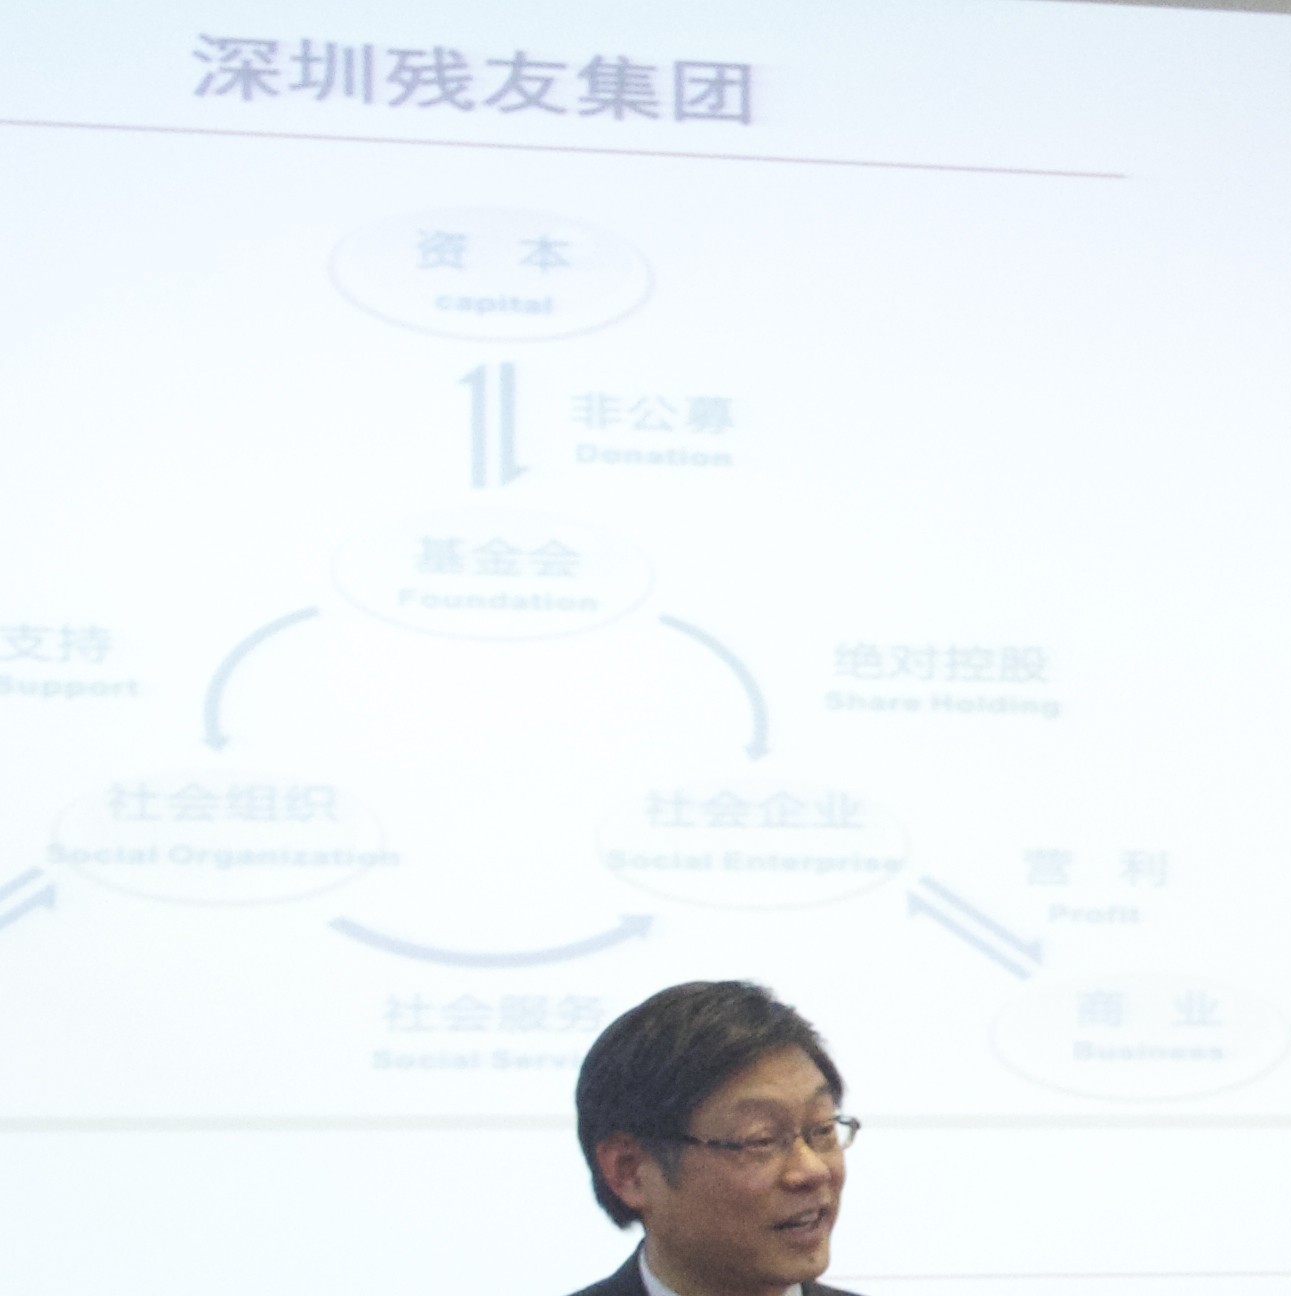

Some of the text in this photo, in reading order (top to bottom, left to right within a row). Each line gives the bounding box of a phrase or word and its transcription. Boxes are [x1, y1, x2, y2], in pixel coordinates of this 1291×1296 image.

[193, 33, 756, 126] 深圳残友集团
[434, 291, 555, 317] capital
[576, 443, 734, 469] Donation
[414, 536, 582, 578] 基金会
[397, 587, 599, 613] Foundation
[824, 689, 1062, 720] Share Holding
[644, 788, 866, 830] 社会企业
[46, 842, 403, 870] Social Organization
[605, 847, 904, 876] Social Enterprise
[1048, 901, 1142, 925] Profit
[372, 1049, 480, 1071] Social
[1073, 1039, 1226, 1064] Business
